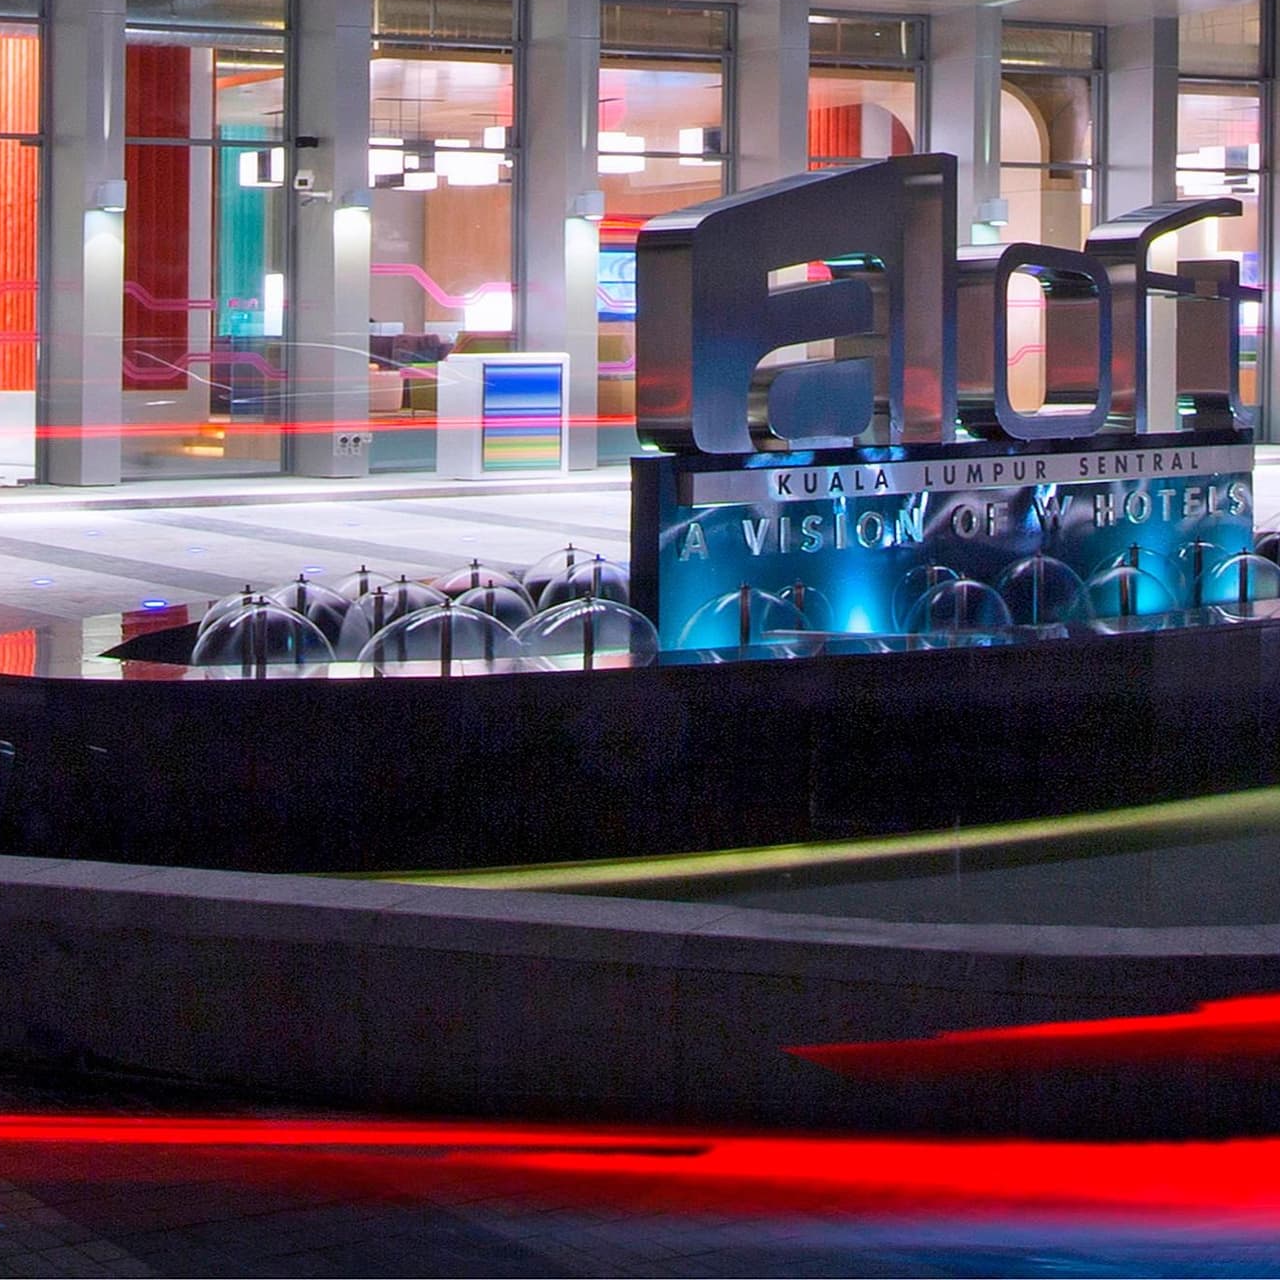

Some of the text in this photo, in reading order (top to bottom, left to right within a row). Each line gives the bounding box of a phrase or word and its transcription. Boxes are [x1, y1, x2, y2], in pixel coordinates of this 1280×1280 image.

[636, 152, 1262, 453] aloft
[778, 451, 1199, 495] KUALA LUMPUR SENTRAL
[679, 481, 1249, 562] A VISION OF W HOTELS
